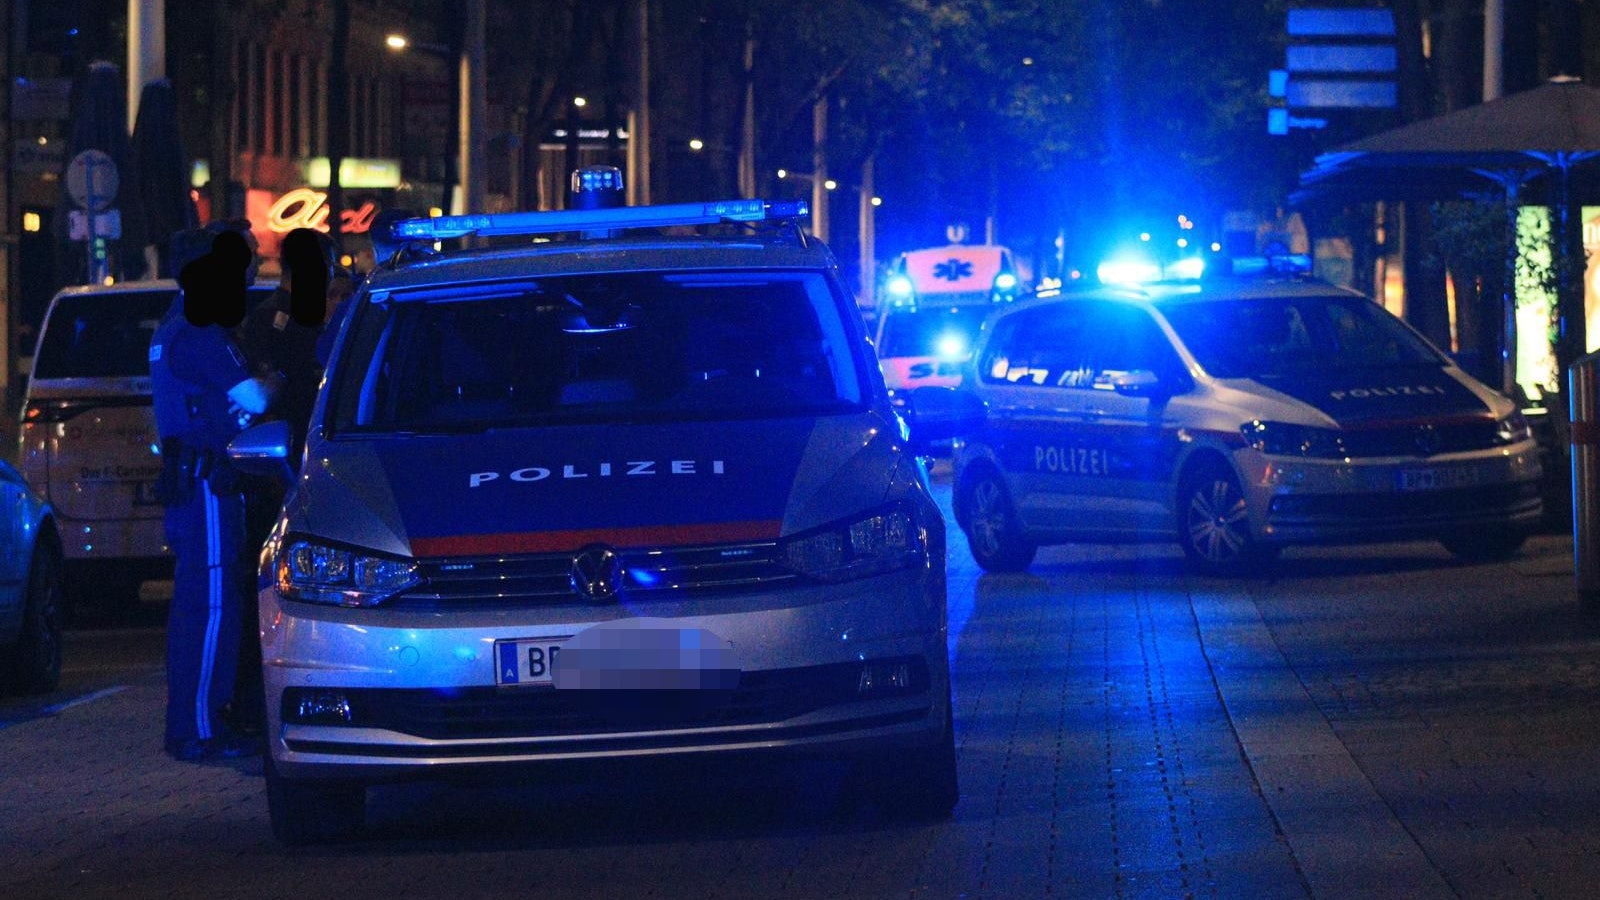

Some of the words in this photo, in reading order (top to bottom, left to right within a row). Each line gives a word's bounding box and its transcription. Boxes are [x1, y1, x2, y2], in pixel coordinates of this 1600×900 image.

[1329, 385, 1445, 400] POLIZEI
[469, 460, 724, 488] POLIZEI
[1034, 445, 1109, 475] POLIZEI
